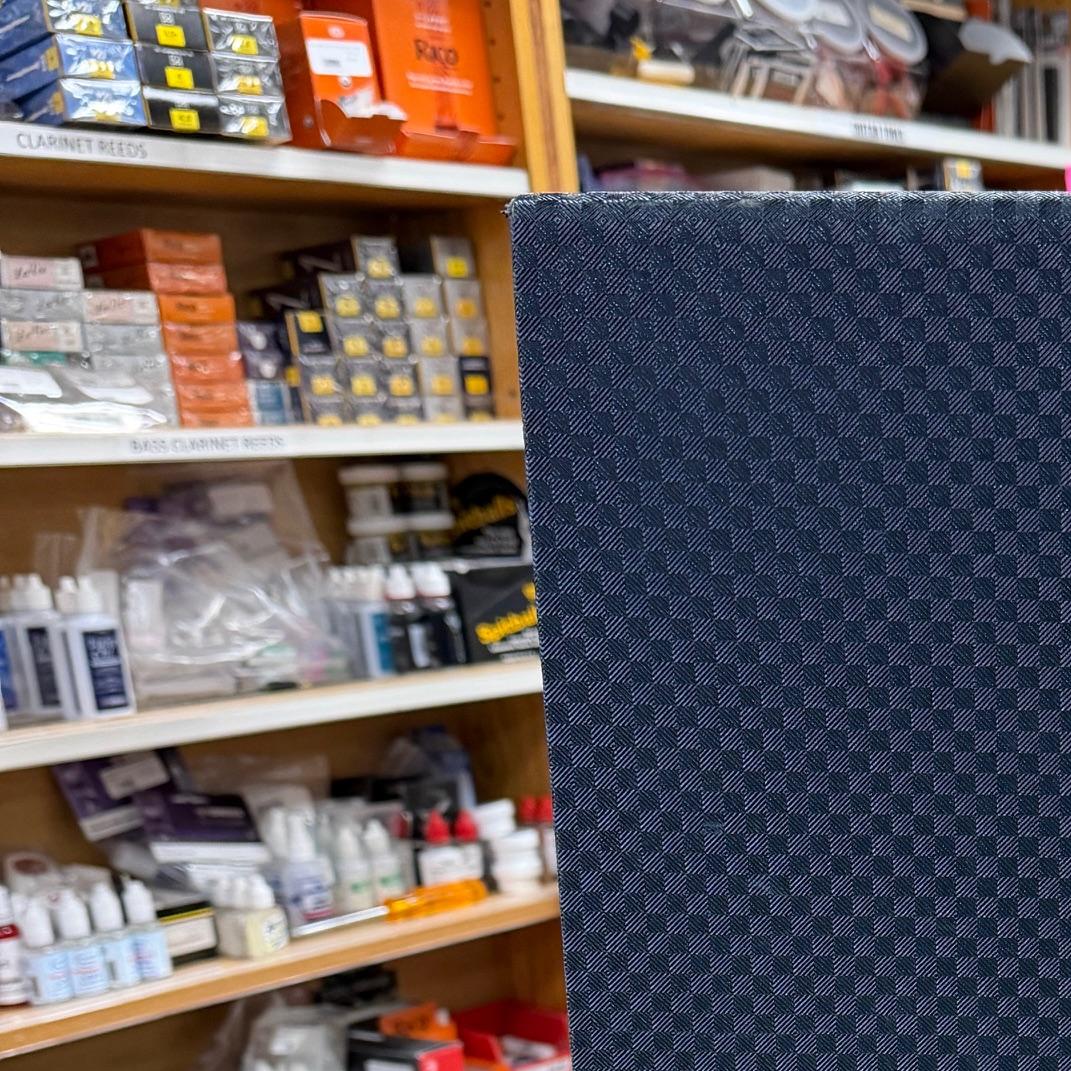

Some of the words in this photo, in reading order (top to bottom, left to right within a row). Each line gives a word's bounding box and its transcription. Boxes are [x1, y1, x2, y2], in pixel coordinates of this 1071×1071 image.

[16, 132, 93, 155] CLARINET
[97, 138, 149, 159] REEDS
[129, 438, 168, 454] BASS
[169, 435, 239, 454] CLARINET
